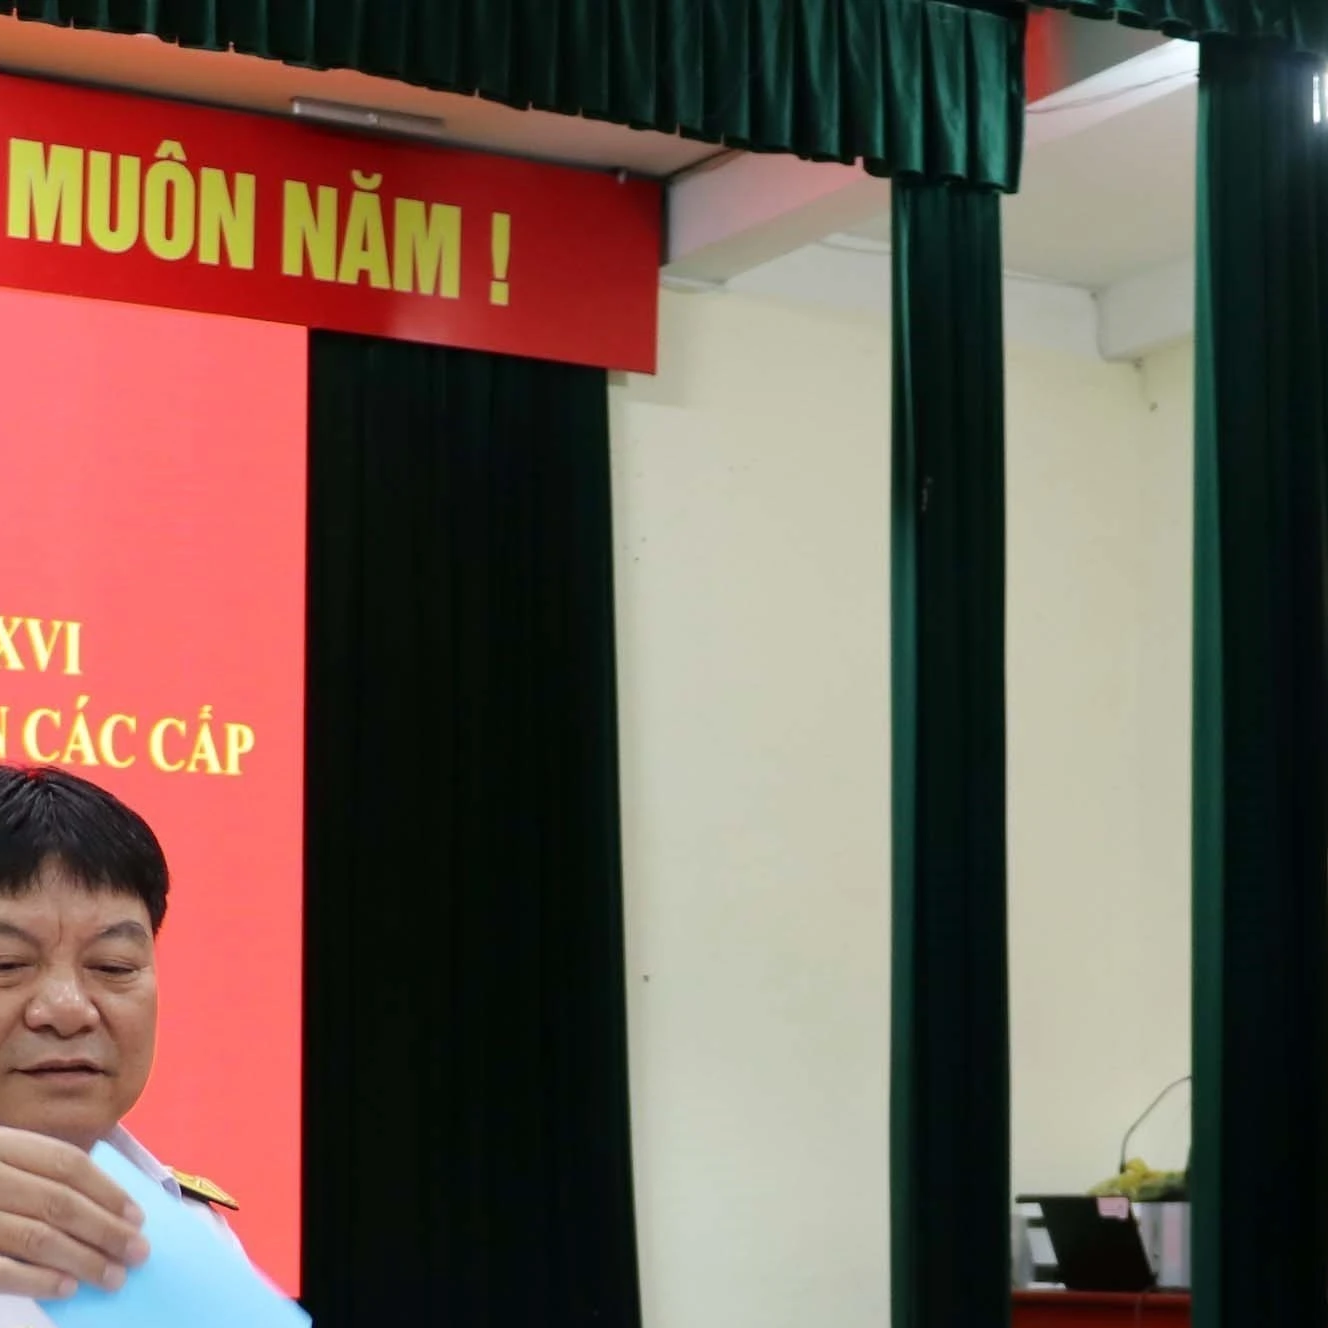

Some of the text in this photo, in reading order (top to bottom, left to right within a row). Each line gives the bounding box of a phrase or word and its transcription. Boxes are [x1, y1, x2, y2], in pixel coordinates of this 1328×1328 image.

[7, 138, 256, 272] MUÔN
[281, 172, 461, 300] NĂM
[488, 212, 512, 307] !
[22, 696, 137, 769] CÁC
[149, 705, 256, 776] CẤP
